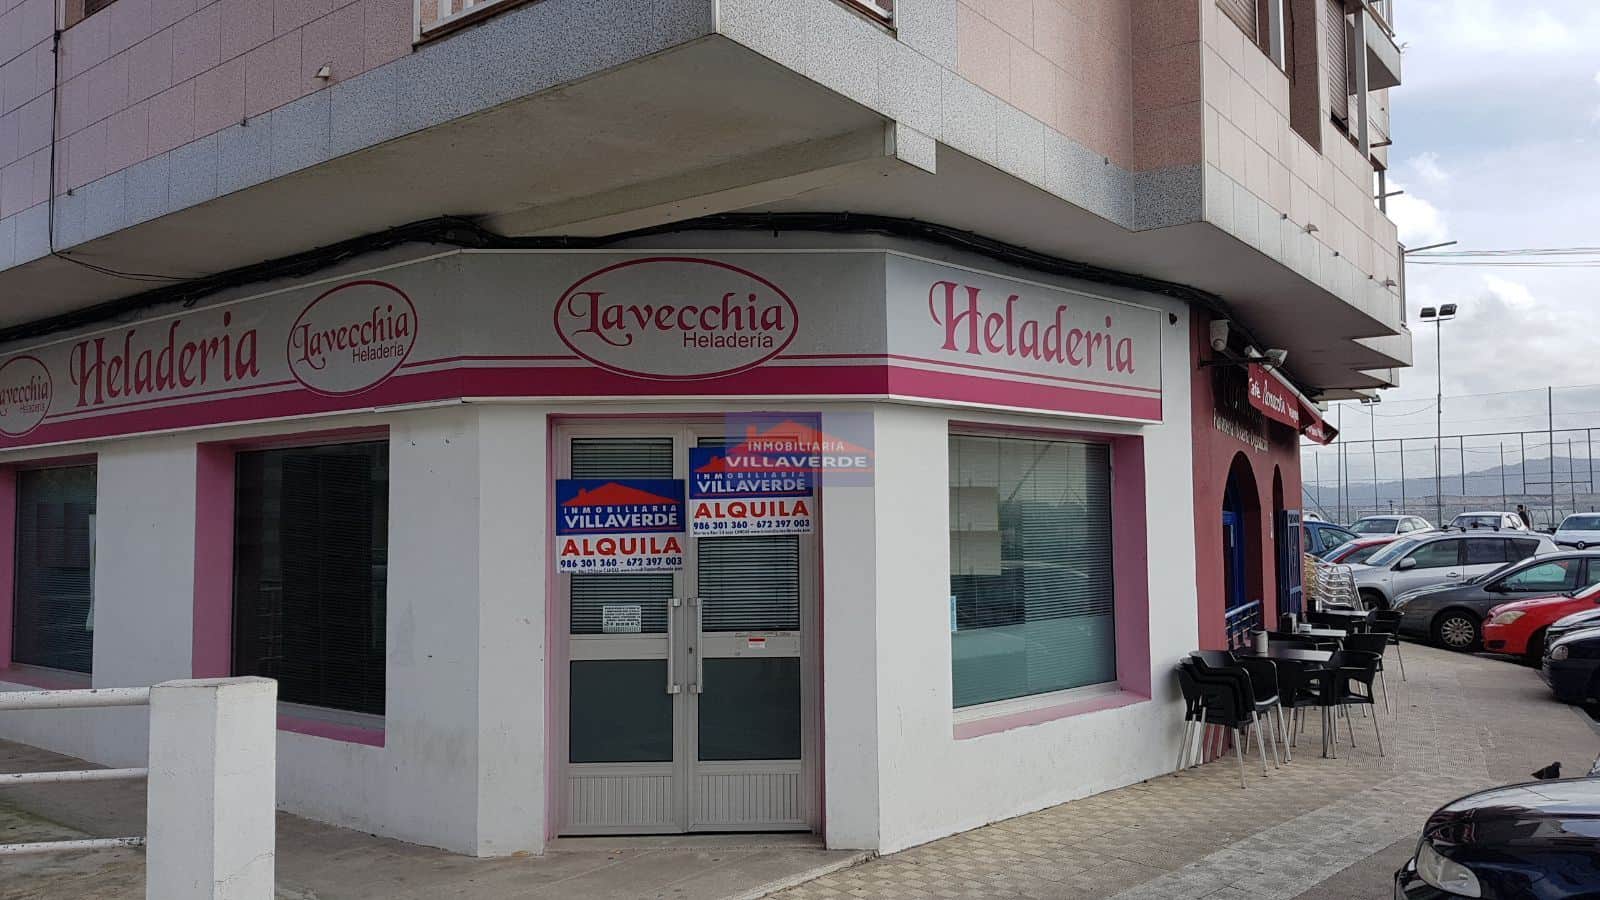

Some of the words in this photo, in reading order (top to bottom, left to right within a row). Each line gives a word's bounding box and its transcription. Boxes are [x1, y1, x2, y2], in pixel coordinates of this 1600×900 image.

[567, 290, 785, 347] Lavecchia
[928, 280, 1135, 374] Heladeria
[293, 304, 409, 370] Lavecchia
[683, 331, 774, 349] Heladería
[70, 311, 260, 407] Heladeria
[0, 375, 49, 417] avecchia
[696, 479, 806, 493] VILLAVERDE
[564, 504, 677, 514] INMOBILIARIA
[694, 500, 809, 519] ALQUILA
[564, 513, 678, 529] VILLAVERDE
[693, 521, 710, 530] 986
[713, 521, 728, 529] 301
[732, 520, 748, 529] 360
[756, 519, 772, 528] 672
[775, 519, 790, 528] 397
[794, 519, 810, 527] 003
[561, 537, 682, 556] ALQUILA
[560, 559, 577, 568] 986
[581, 559, 596, 568] 301
[600, 558, 617, 567] 360
[626, 558, 643, 566] 672
[646, 557, 662, 566] 397
[666, 557, 682, 565] 003
